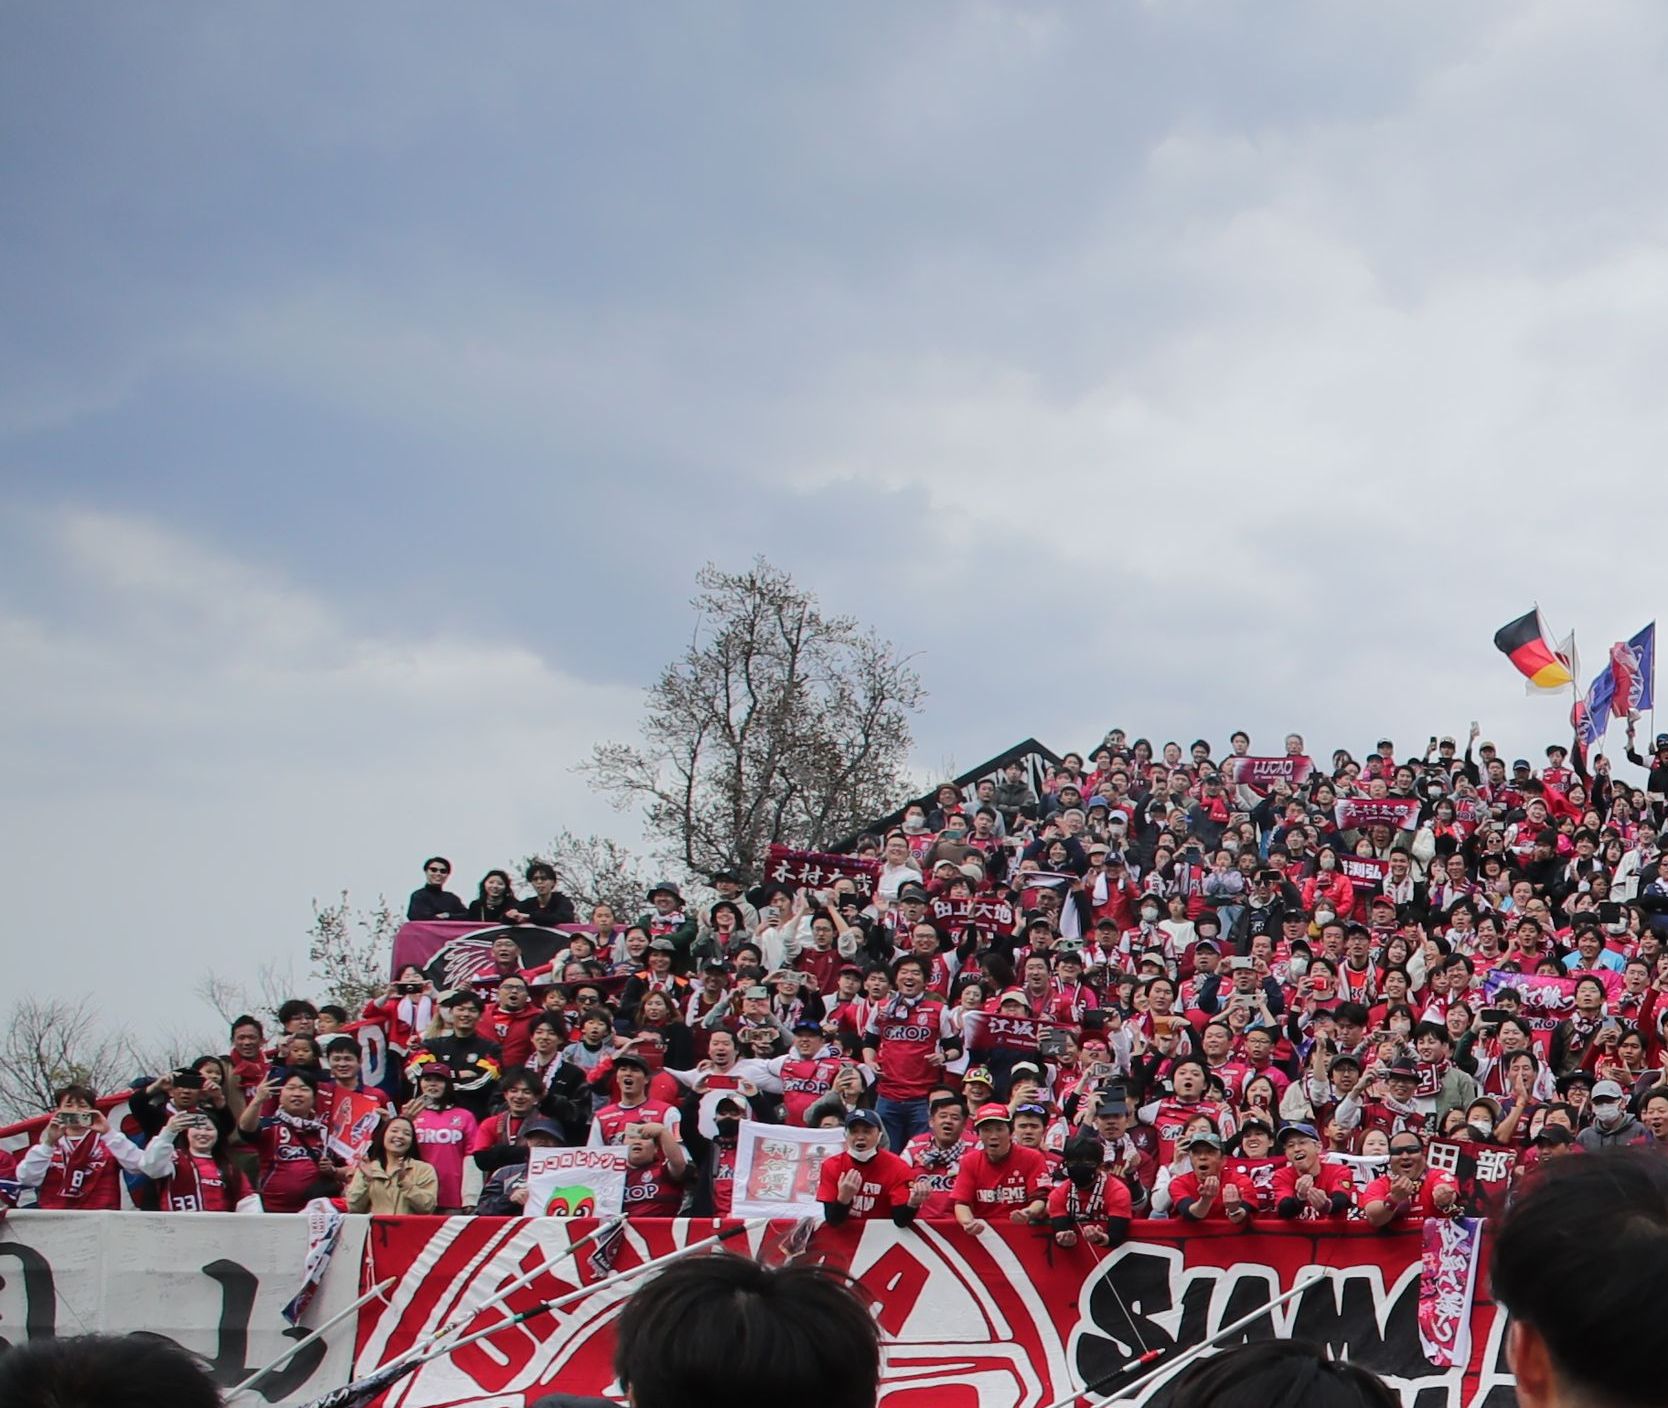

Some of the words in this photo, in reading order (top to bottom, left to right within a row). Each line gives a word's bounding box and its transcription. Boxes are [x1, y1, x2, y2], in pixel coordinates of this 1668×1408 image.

[1253, 760, 1294, 776] LUCAO
[934, 901, 1013, 925] 田上大地
[884, 1026, 931, 1041] GROP
[173, 1194, 196, 1211] 33
